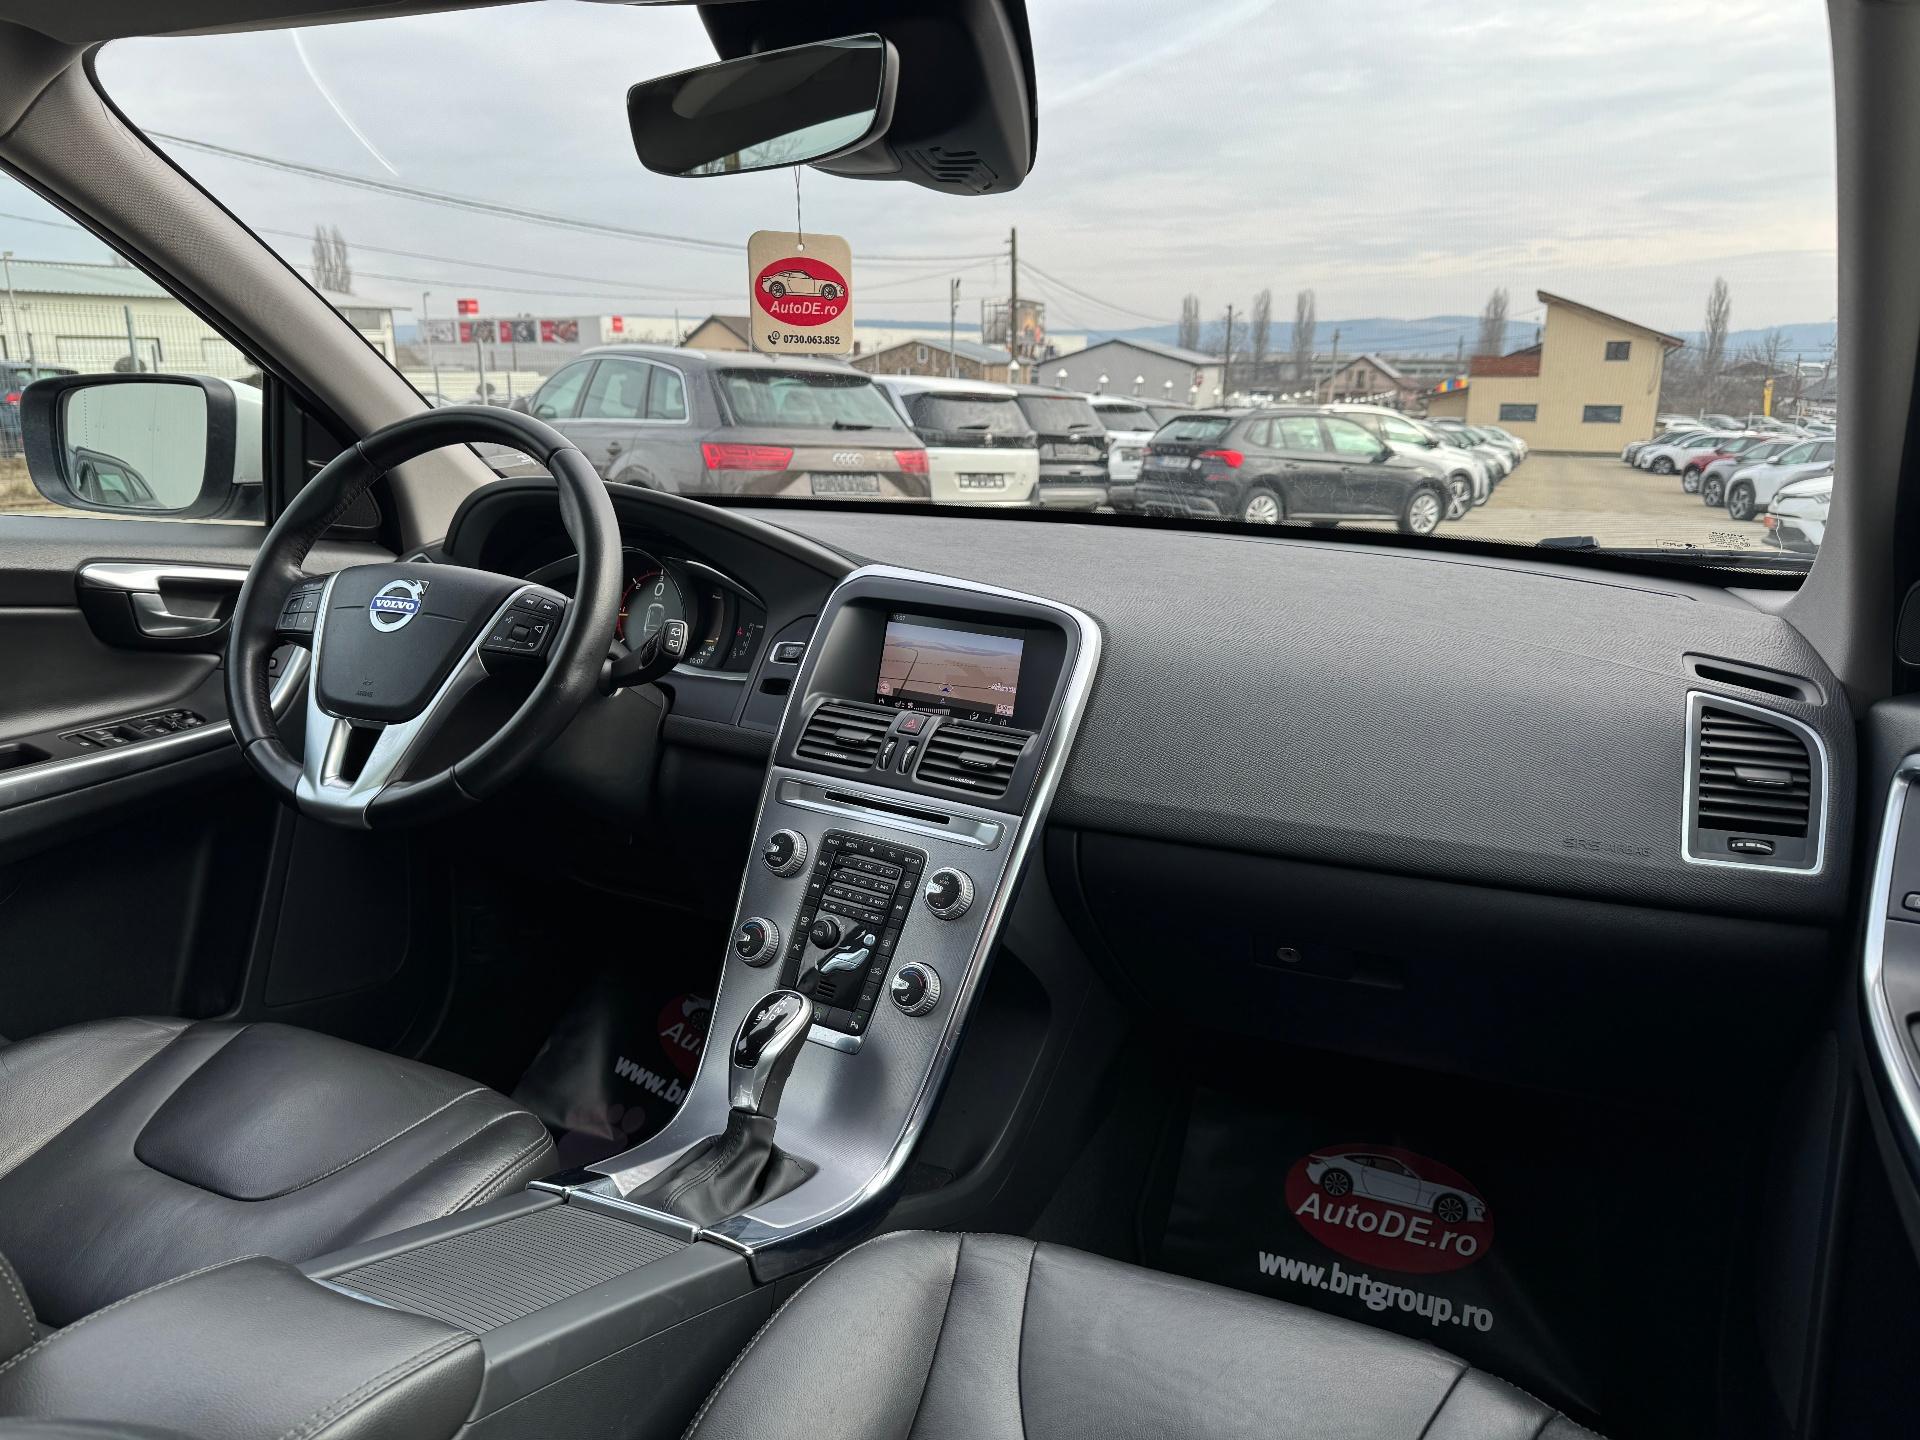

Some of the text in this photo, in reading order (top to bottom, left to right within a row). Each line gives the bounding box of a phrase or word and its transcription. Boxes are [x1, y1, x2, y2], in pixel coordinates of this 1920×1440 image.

[770, 300, 838, 316] AutoDE.ro
[783, 334, 840, 345] 0730.063.852
[654, 582, 665, 597] 0
[375, 599, 415, 610] VOLVO
[660, 1022, 701, 1055] Au
[1295, 1193, 1478, 1257] AutoDE.ro
[1258, 1251, 1494, 1332] www.brtgroup.ro
